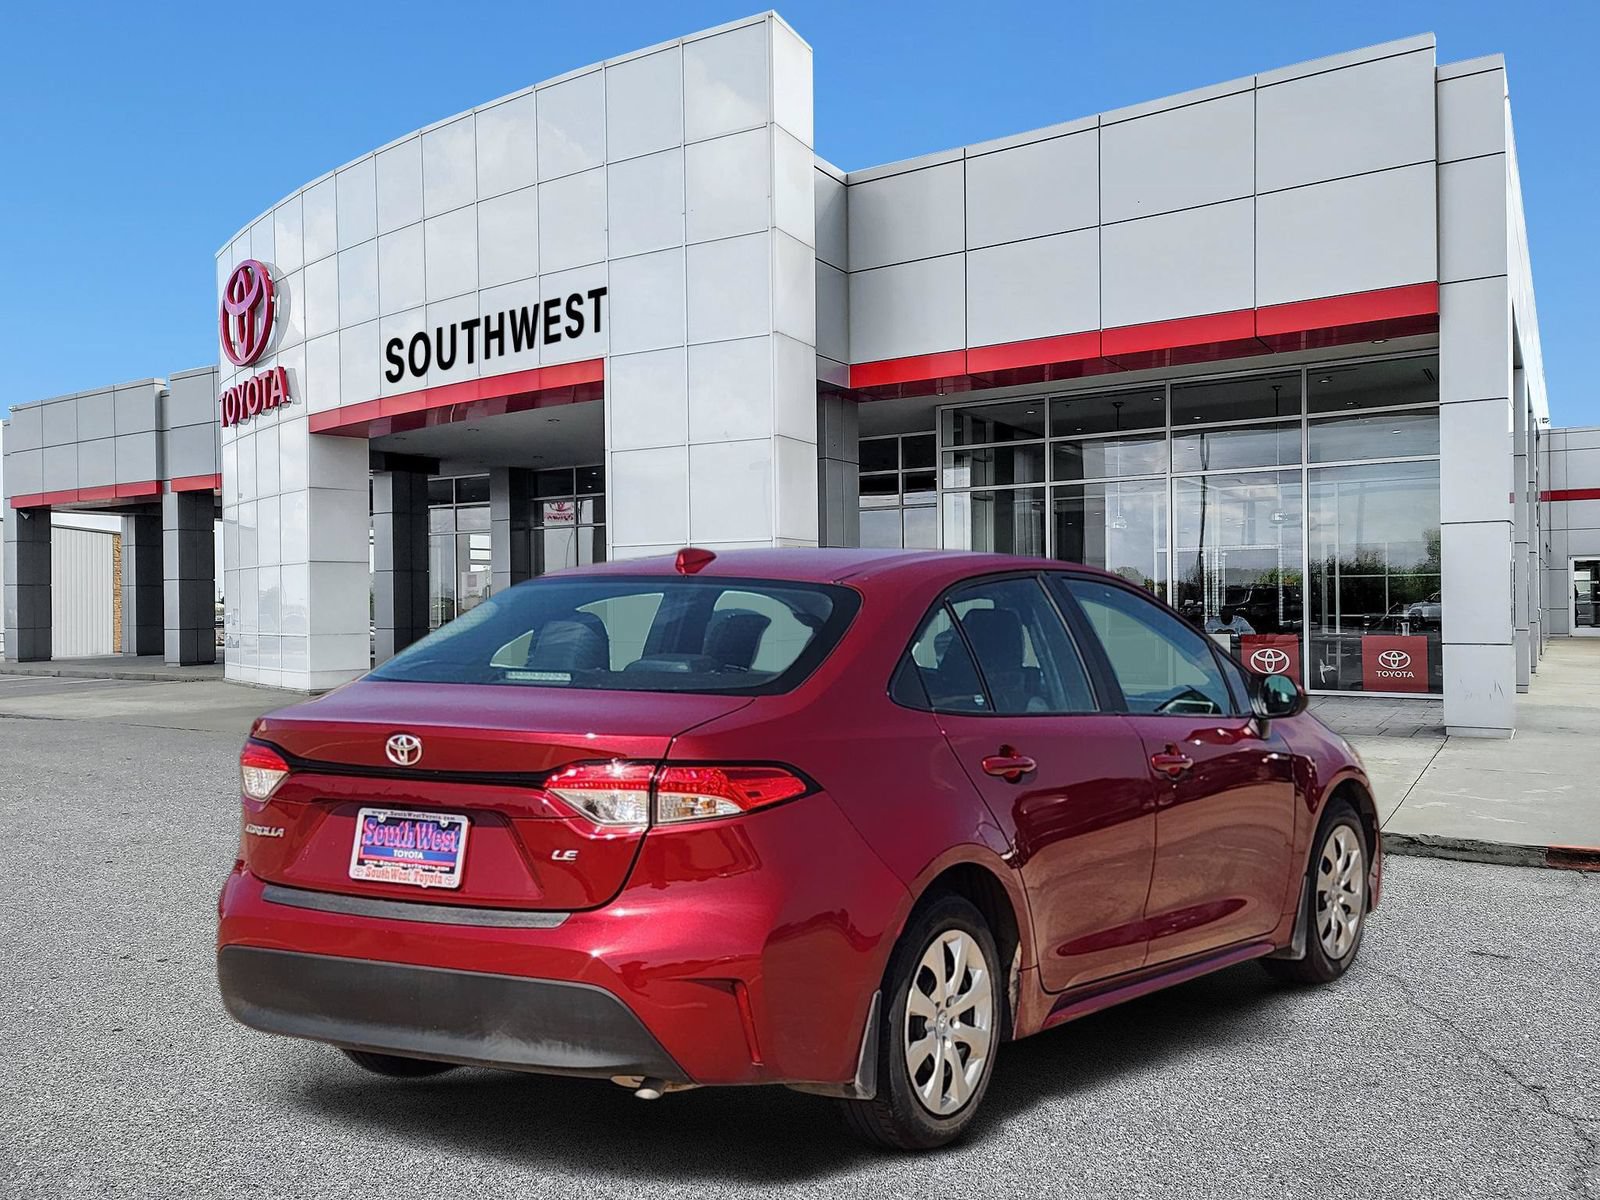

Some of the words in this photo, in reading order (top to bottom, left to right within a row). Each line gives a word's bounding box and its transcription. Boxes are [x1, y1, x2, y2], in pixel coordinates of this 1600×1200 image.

[385, 287, 608, 383] SOUTHWEST
[218, 366, 288, 428] TOYOTA
[1376, 670, 1414, 678] TOYOTA
[393, 849, 424, 860] TOYOTA
[551, 849, 579, 861] LE
[414, 871, 443, 885] Toyota
